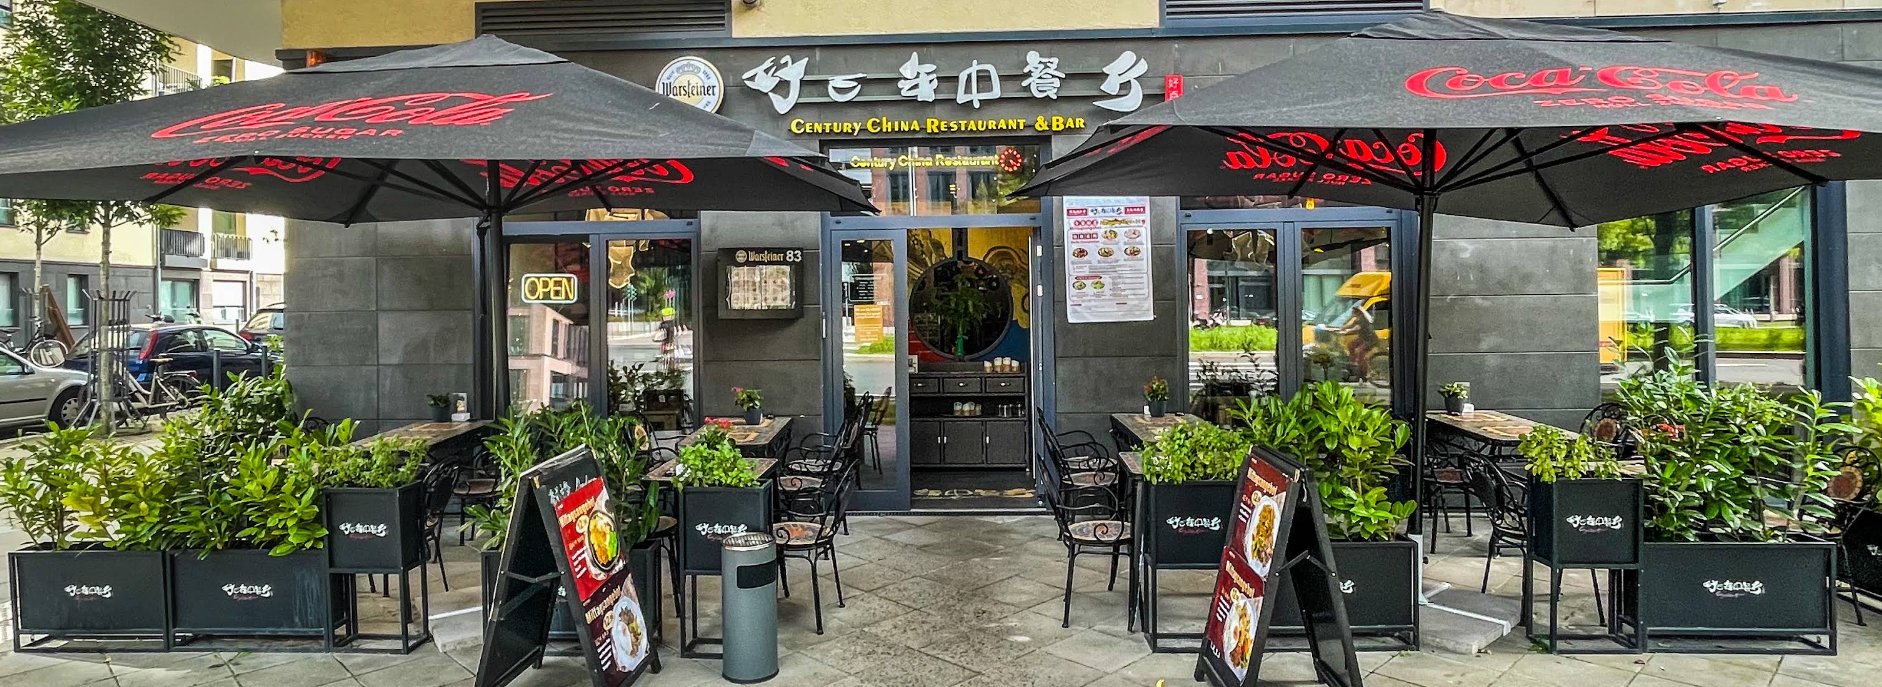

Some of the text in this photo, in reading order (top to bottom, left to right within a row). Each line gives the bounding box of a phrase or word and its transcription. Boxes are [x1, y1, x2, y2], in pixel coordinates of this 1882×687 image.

[662, 80, 717, 98] Warsteiner
[1405, 66, 1799, 103] Coca-Cola
[926, 115, 1027, 133] RESTAURANT
[849, 153, 1000, 171] Century China Restaurant
[748, 249, 785, 263] Warsteiner
[786, 249, 802, 262] 83
[524, 277, 574, 300] OPEN
